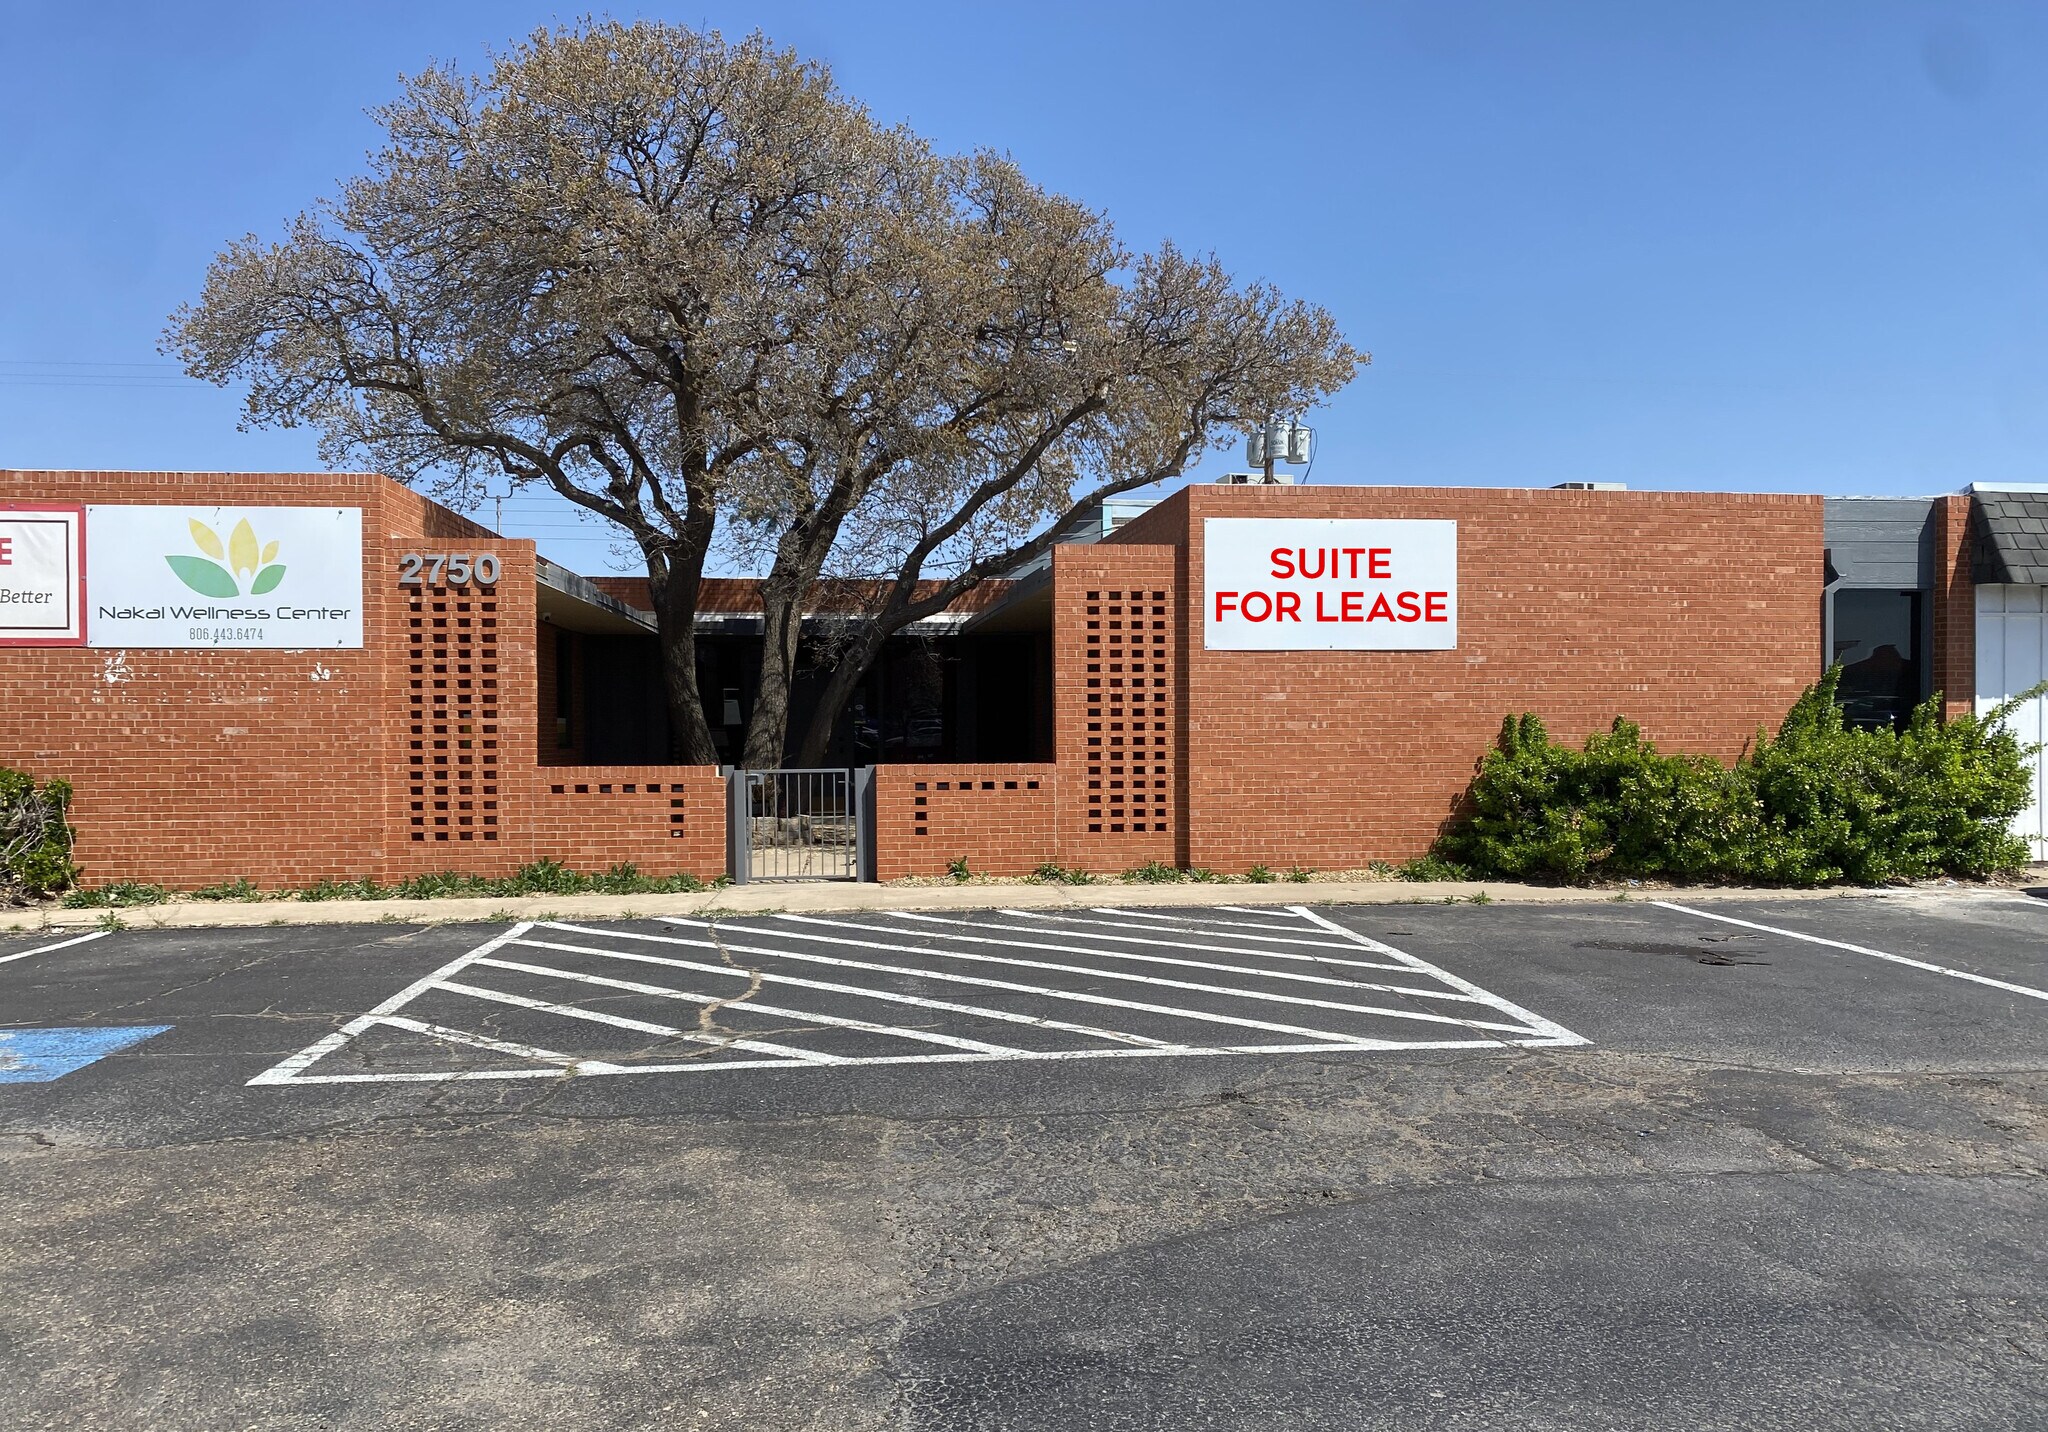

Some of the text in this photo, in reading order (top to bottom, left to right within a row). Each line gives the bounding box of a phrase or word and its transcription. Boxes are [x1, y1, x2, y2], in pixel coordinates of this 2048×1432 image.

[399, 553, 501, 585] 2750
[1270, 547, 1392, 580] SUITE
[0, 588, 53, 604] Better
[1215, 591, 1448, 623] FOR LEASE
[99, 606, 351, 620] Nakal Wellness Center
[189, 627, 263, 640] 806.443.6474
